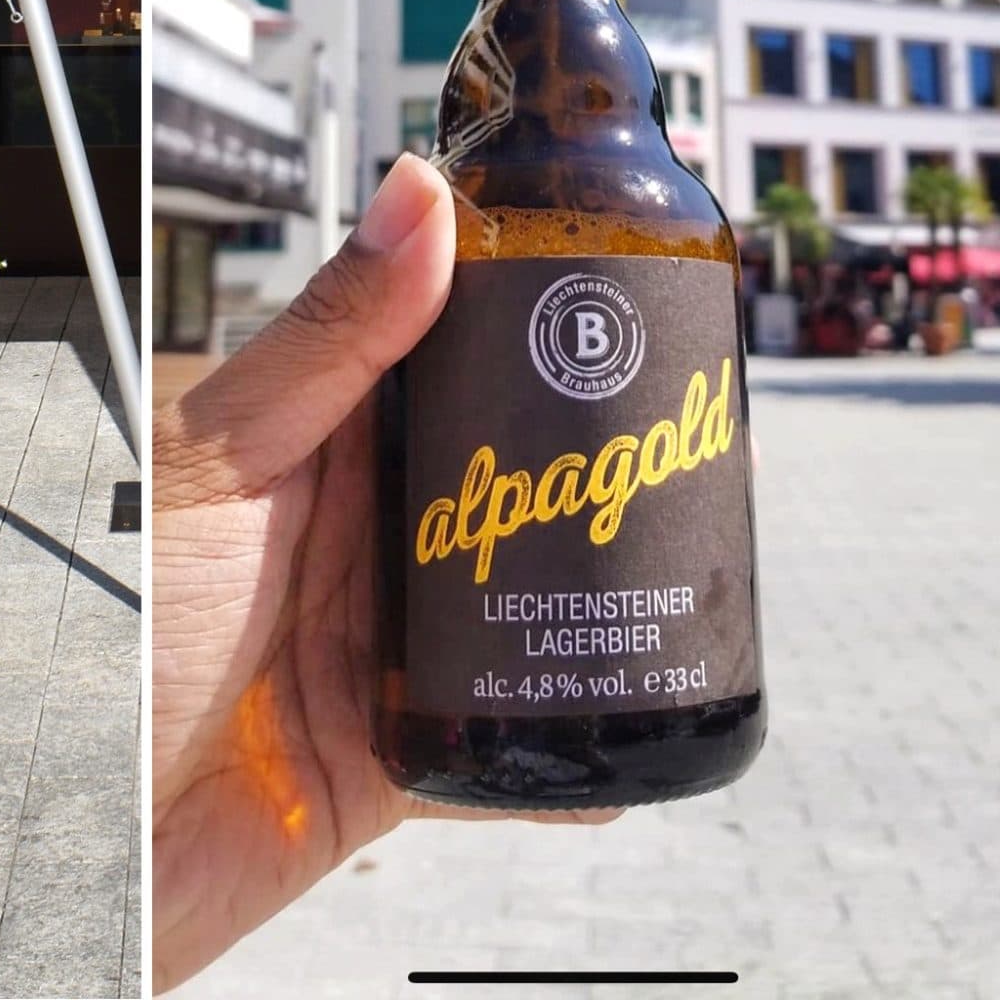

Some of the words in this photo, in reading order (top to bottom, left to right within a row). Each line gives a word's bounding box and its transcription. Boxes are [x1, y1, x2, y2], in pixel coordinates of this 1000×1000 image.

[542, 281, 635, 318] Liechtensteiner
[574, 311, 611, 360] B
[560, 371, 623, 392] Brauhaus
[415, 357, 735, 585] alpagold
[483, 586, 695, 622] LIECHTENSTEINER
[525, 623, 662, 657] LAGERBIER
[473, 671, 514, 698] alc.
[588, 668, 633, 696] vol.
